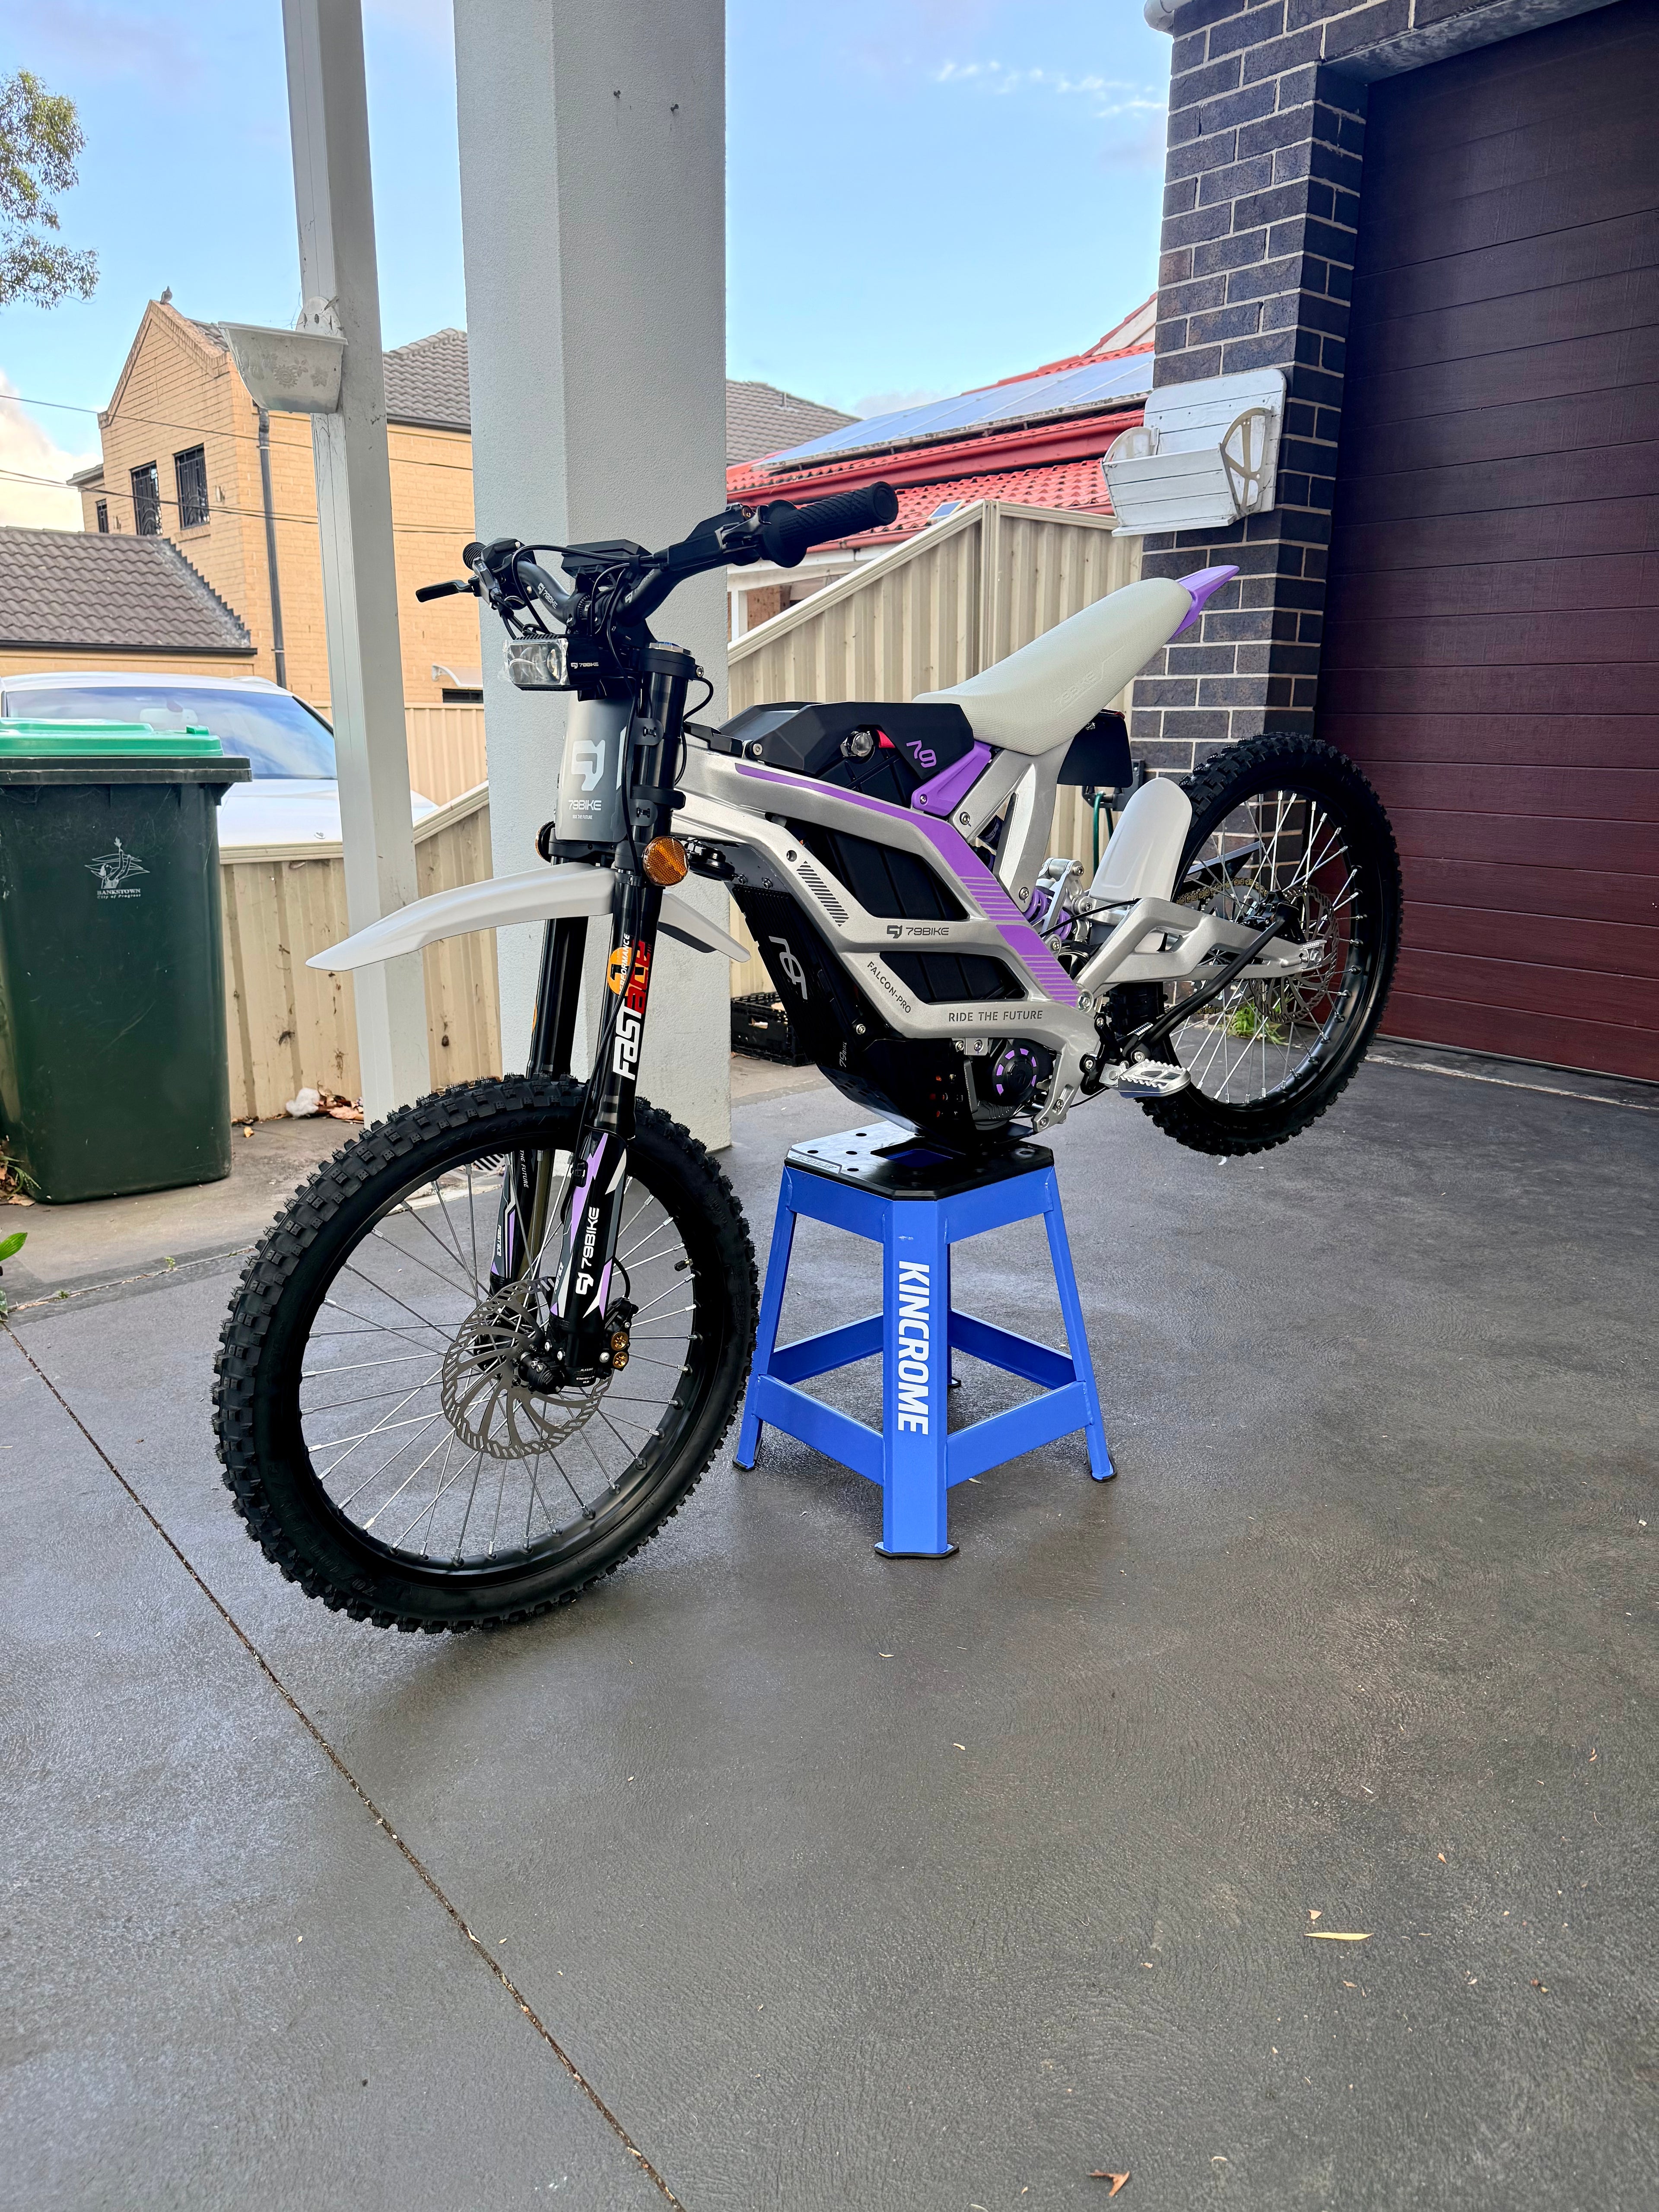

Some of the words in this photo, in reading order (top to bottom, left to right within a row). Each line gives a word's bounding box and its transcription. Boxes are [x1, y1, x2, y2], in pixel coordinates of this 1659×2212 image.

[906, 740, 937, 768] 79
[568, 800, 602, 811] 79BIKE
[906, 927, 950, 936] 79BIKE
[619, 933, 630, 995] ERFORMANCE
[867, 961, 912, 1014] FALCON-PRO
[948, 1012, 973, 1022] RIDE
[978, 1011, 998, 1021] THE
[1003, 1010, 1043, 1020] FUTURE
[581, 1206, 600, 1269] 79BIKE
[898, 1260, 930, 1435] KINCROME
